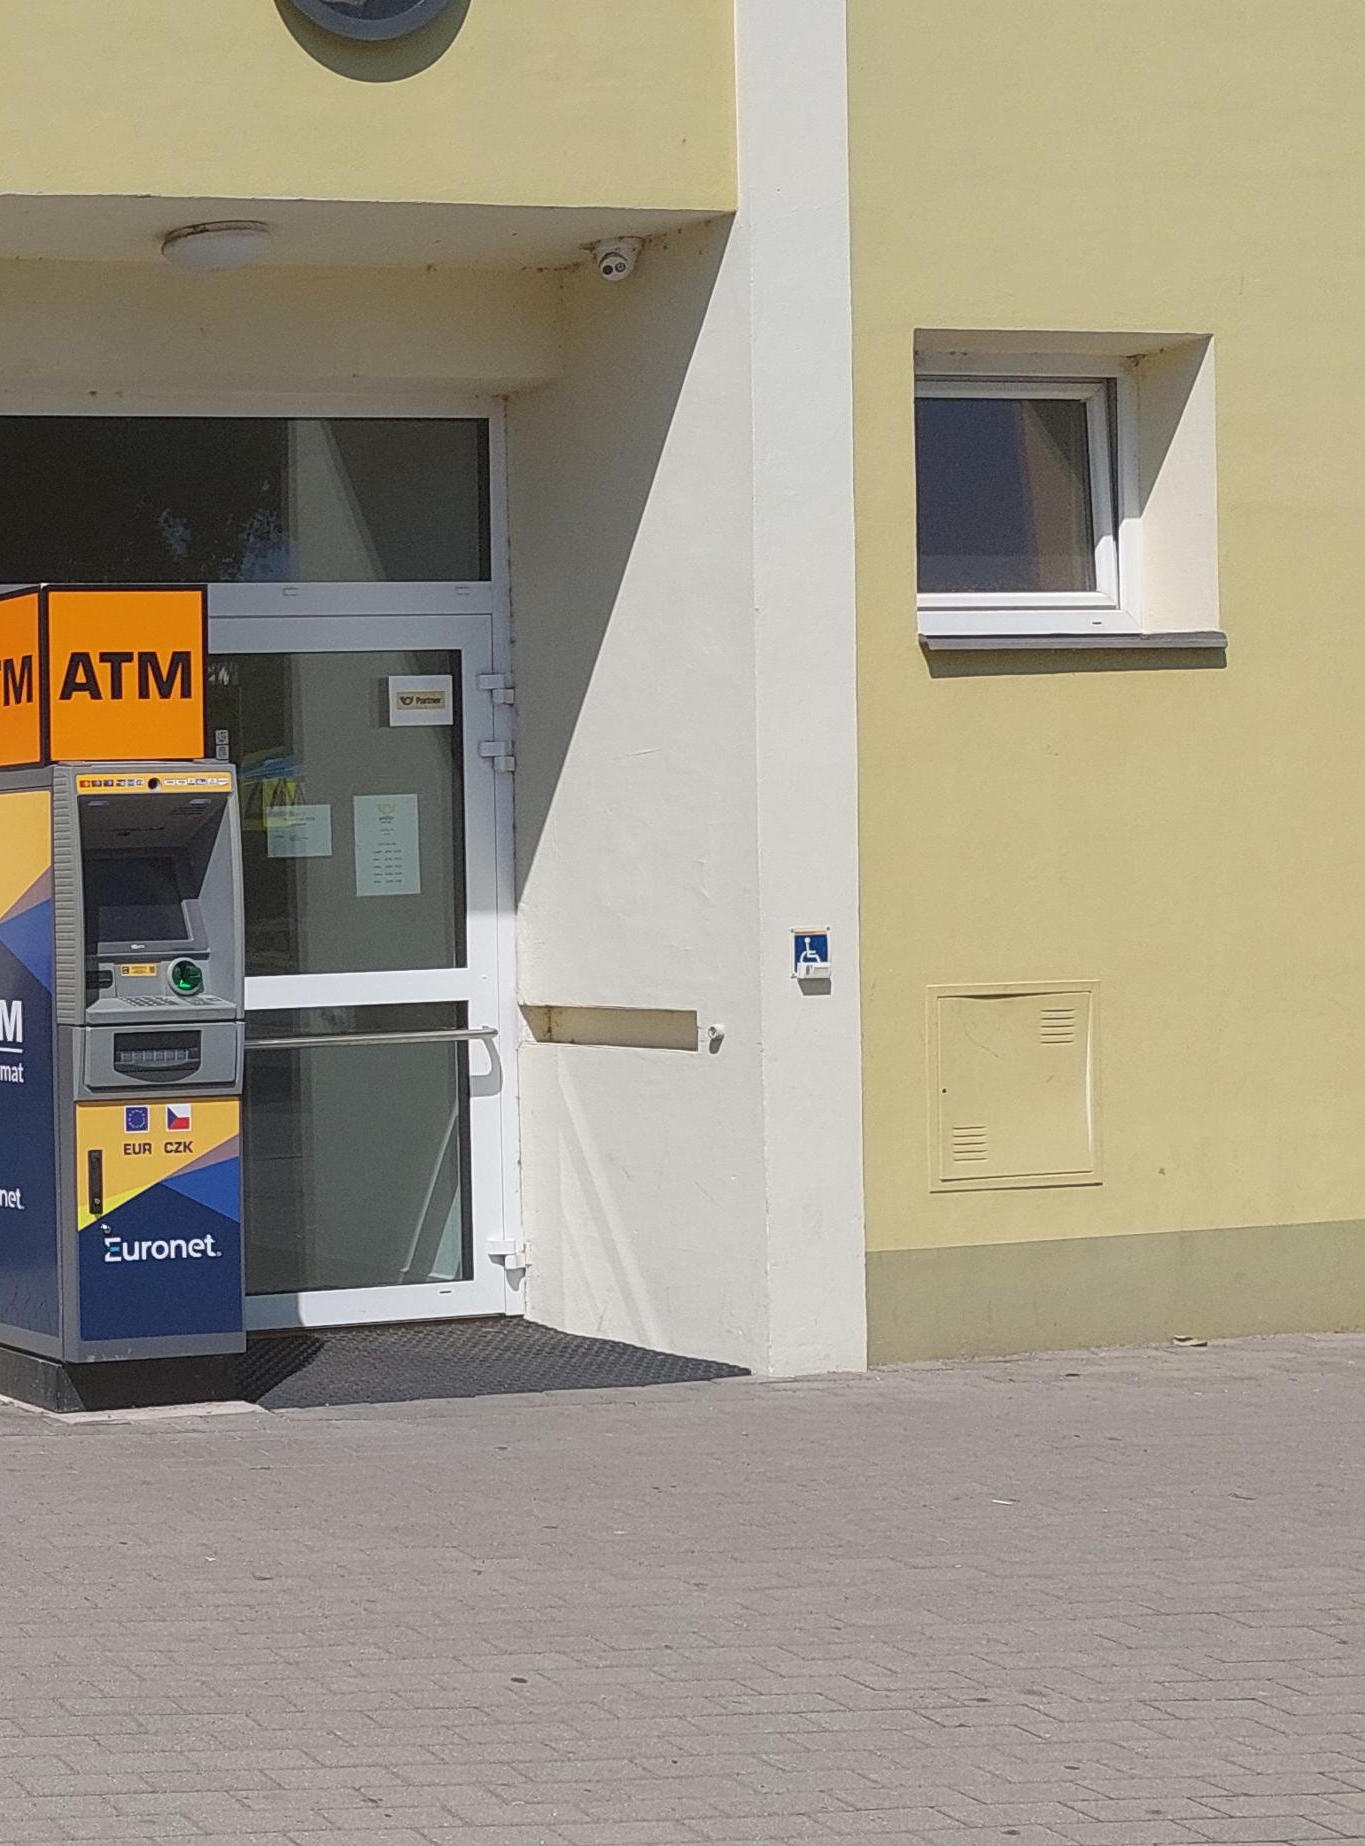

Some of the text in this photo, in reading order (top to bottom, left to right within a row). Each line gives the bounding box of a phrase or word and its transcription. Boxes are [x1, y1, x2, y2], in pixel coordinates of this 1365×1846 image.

[59, 650, 193, 700] ATM
[123, 1140, 194, 1156] EUR CZK
